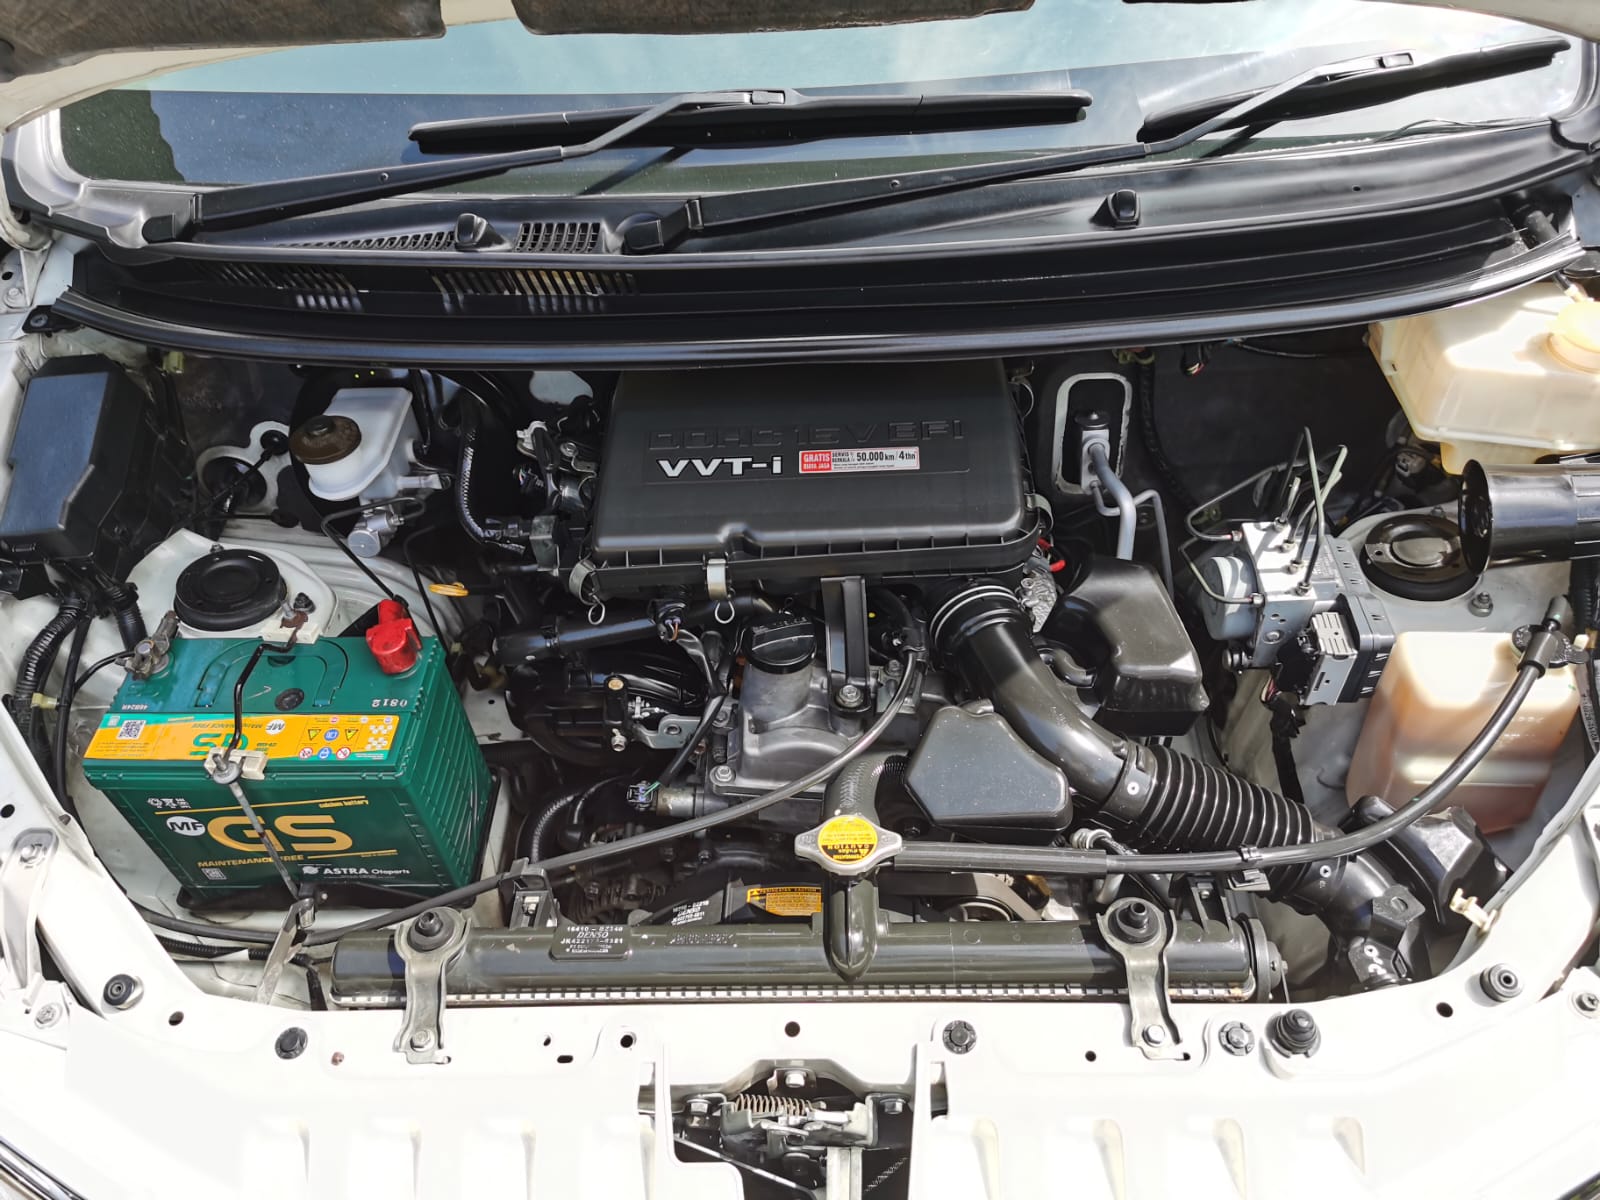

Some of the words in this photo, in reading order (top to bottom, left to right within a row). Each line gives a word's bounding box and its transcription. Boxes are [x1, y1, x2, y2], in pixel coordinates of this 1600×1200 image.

[888, 419, 964, 441] EFI
[803, 453, 831, 463] GRATIS
[856, 451, 884, 462] 50.000
[884, 453, 895, 461] km
[905, 451, 916, 460] thn
[657, 456, 782, 478] VVT-i
[371, 699, 408, 708] 0812
[265, 722, 285, 731] MF
[343, 799, 369, 807] battery
[168, 821, 204, 833] MF
[207, 815, 353, 852] GS
[280, 854, 304, 862] REE
[323, 867, 369, 875] ASTRA
[577, 931, 609, 939] DENSO
